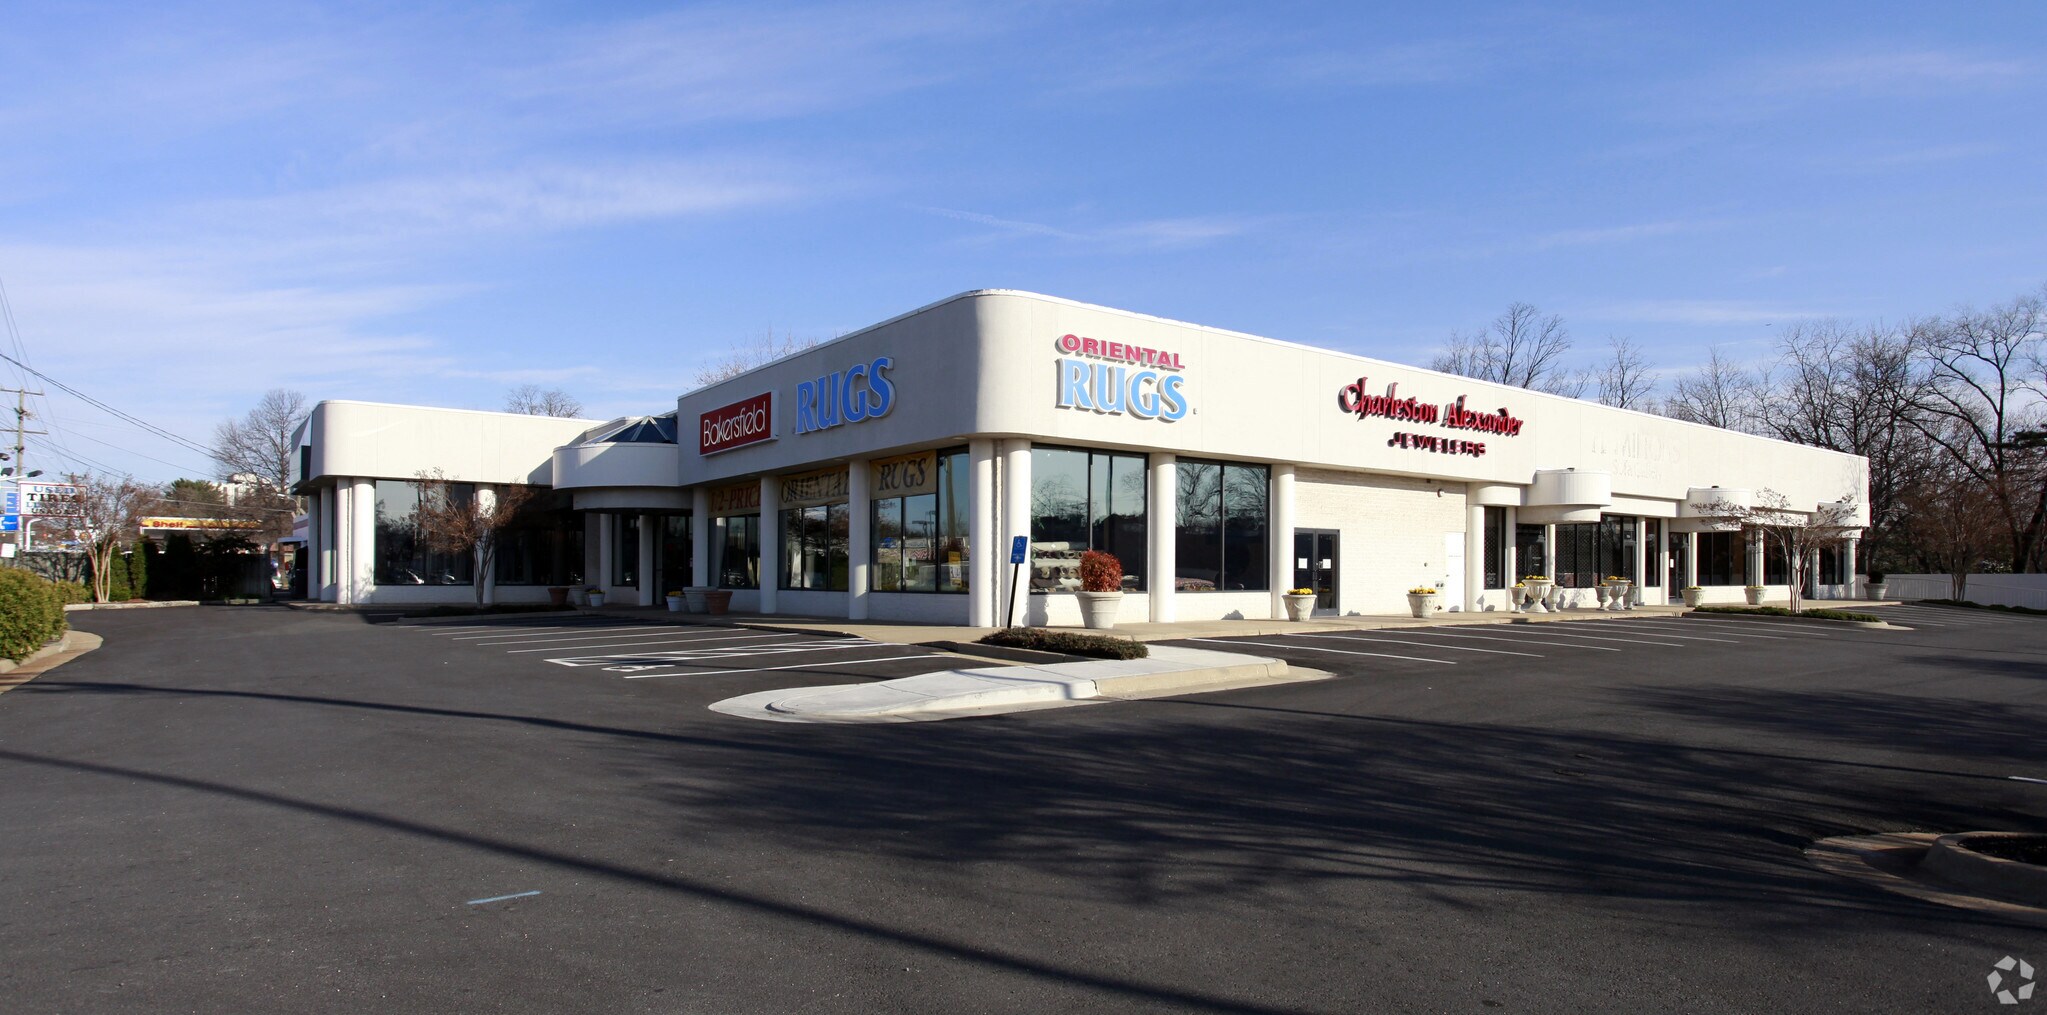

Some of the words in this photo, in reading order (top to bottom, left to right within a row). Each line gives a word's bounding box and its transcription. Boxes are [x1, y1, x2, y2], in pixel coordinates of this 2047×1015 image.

[1058, 333, 1185, 370] ORIENTAL
[794, 356, 895, 435] RUGS
[1058, 358, 1188, 421] RUGS
[1340, 376, 1439, 422] Charleston
[1444, 394, 1524, 436] Alexander
[702, 401, 766, 447] Bakersfield
[1390, 432, 1486, 457] JEWELERS
[878, 457, 927, 491] RUGS
[152, 520, 184, 528] Shell
